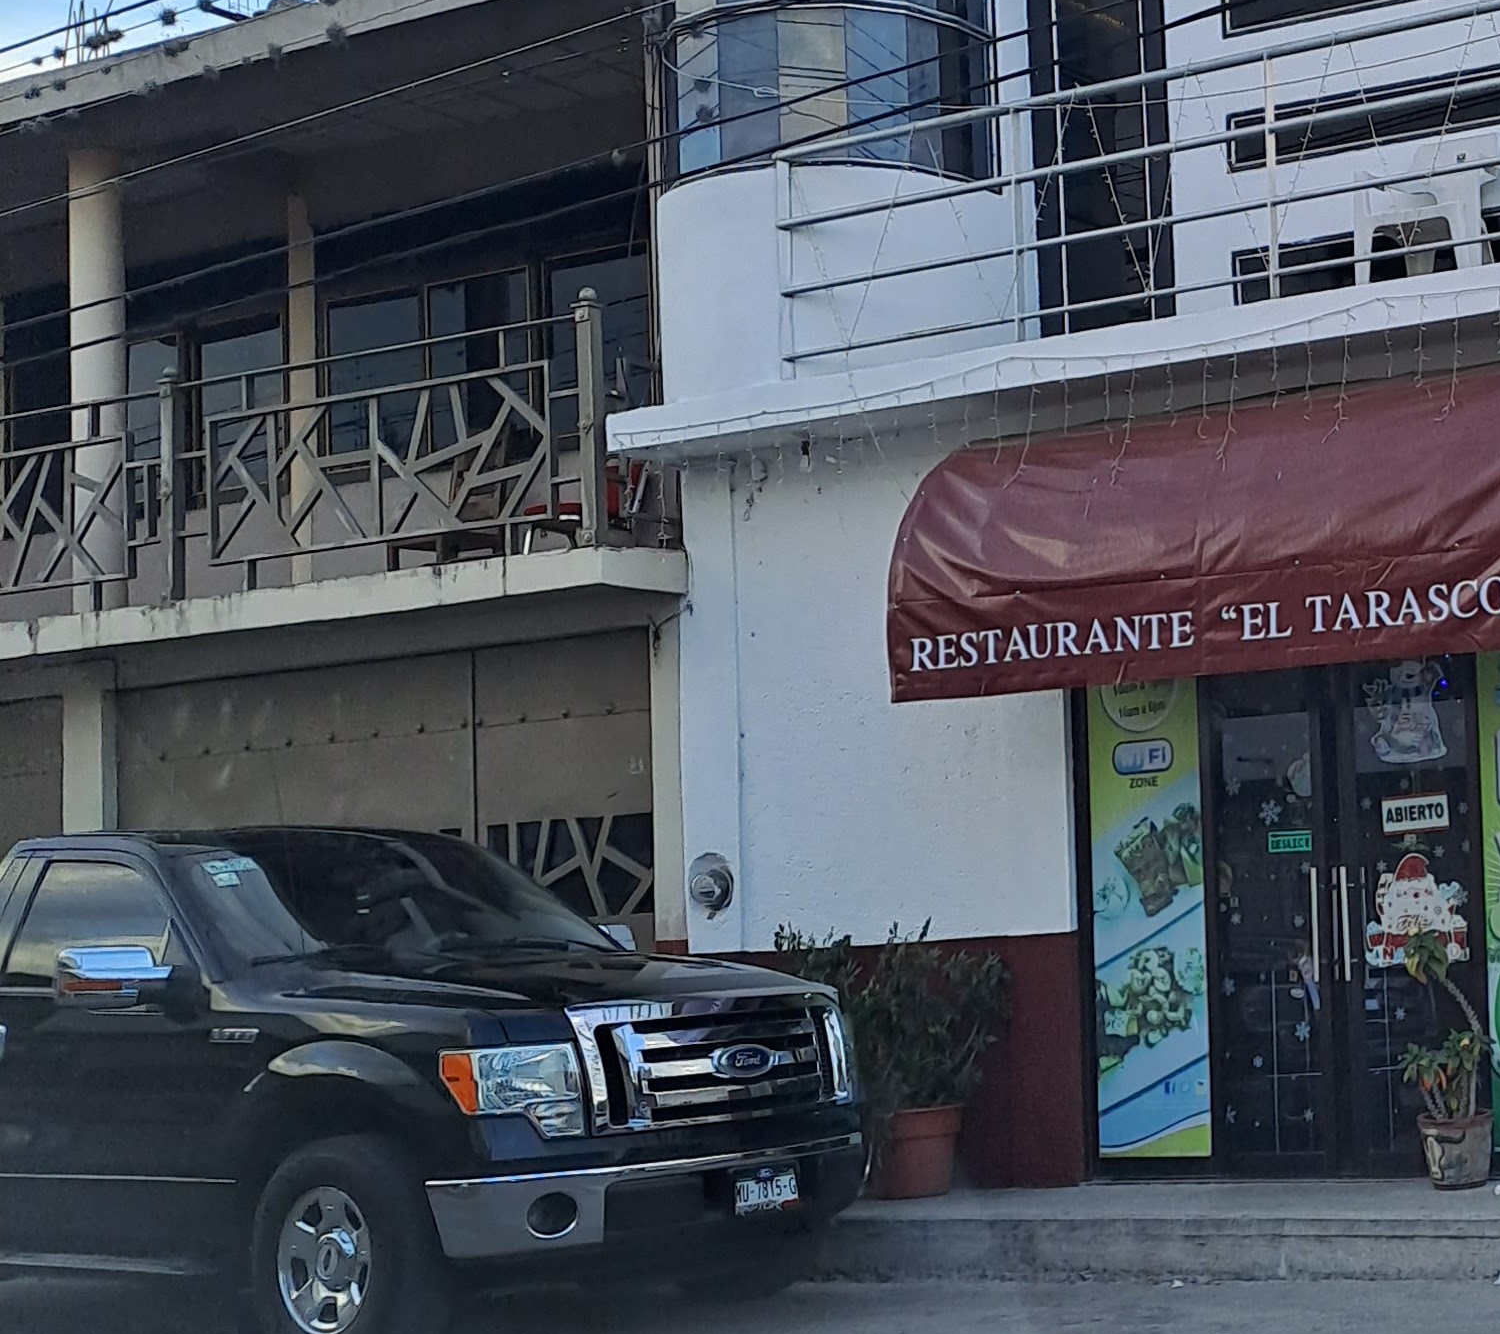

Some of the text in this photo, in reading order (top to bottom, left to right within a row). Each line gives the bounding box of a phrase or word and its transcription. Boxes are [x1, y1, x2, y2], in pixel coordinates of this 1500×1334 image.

[909, 610, 1195, 671] RESTAURANTE
[1129, 776, 1159, 789] ZONE
[1385, 802, 1445, 824] ABIERTO
[735, 1051, 761, 1067] Ford
